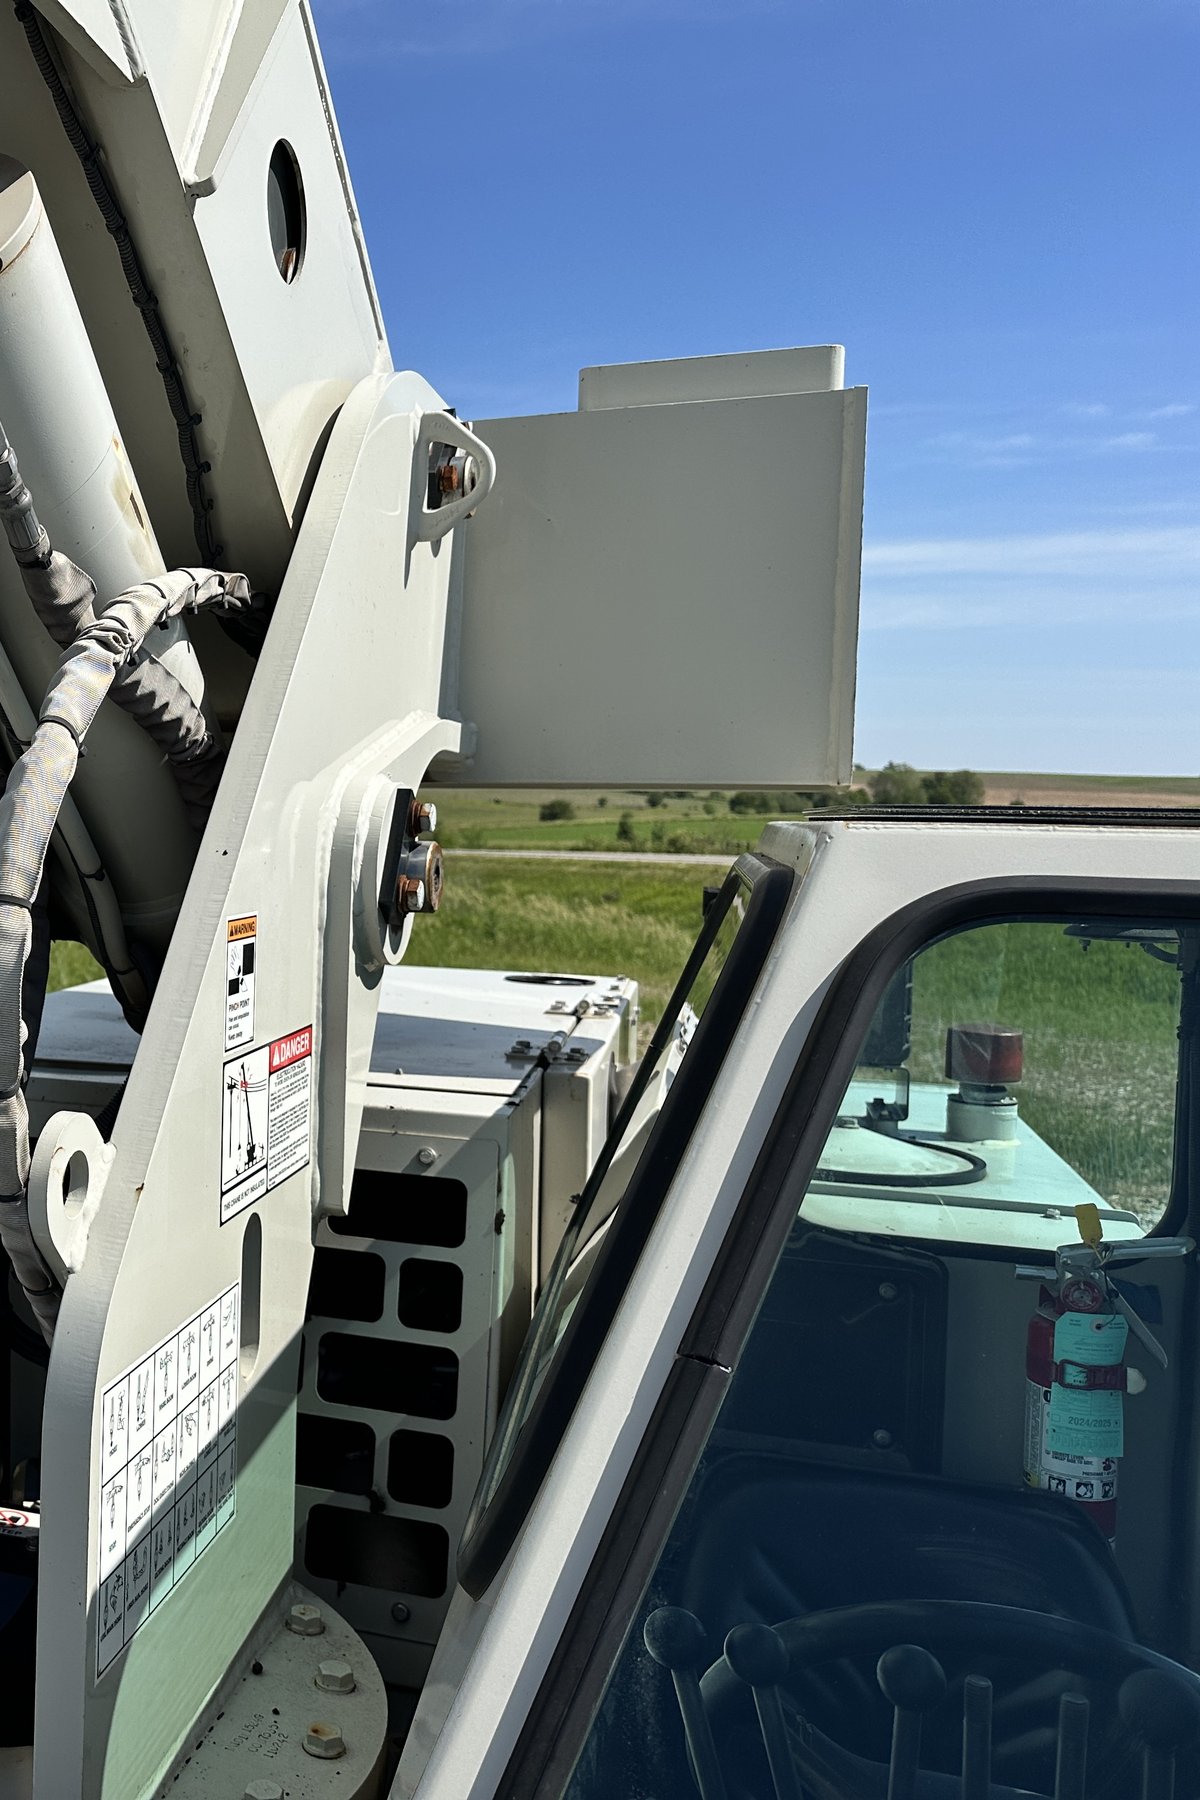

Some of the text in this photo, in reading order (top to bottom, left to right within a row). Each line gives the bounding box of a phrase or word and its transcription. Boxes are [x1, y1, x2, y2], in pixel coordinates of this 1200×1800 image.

[234, 921, 255, 935] WARNING
[240, 998, 250, 1008] POINT
[280, 1032, 310, 1062] DANGER
[1068, 1416, 1111, 1428] 2024/2025
